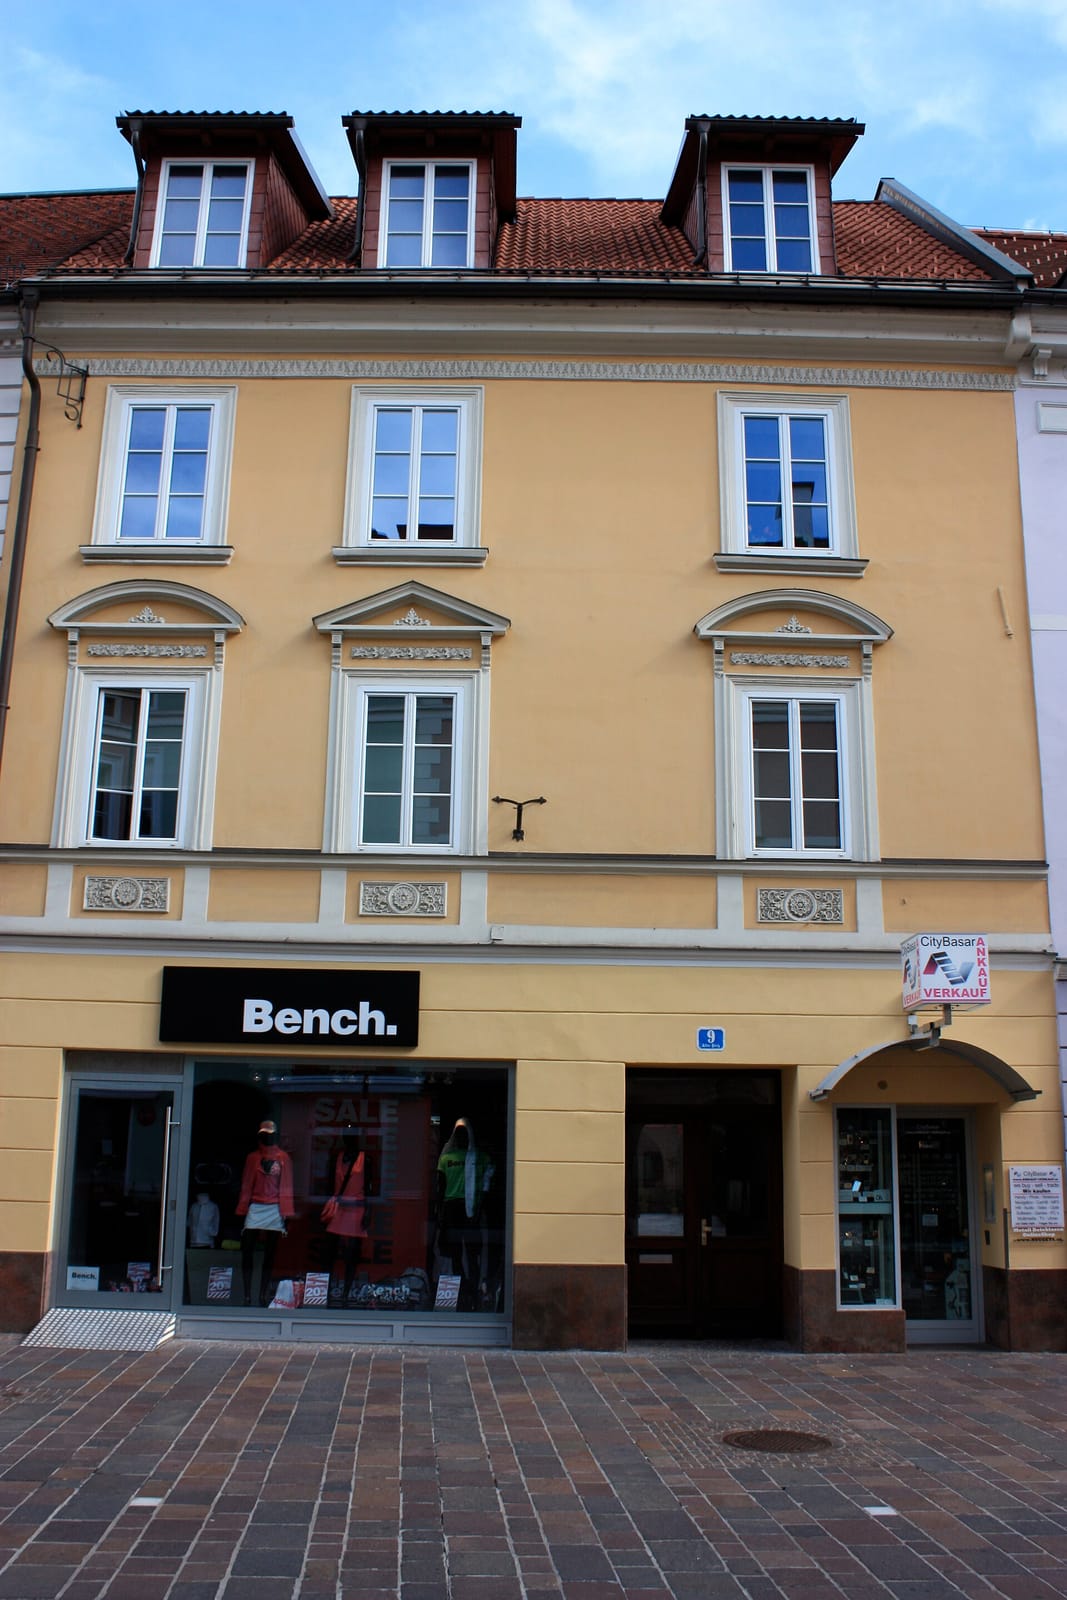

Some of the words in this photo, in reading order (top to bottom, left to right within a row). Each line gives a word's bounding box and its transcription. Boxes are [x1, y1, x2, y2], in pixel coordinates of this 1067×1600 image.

[921, 936, 975, 949] CityBasar
[924, 988, 987, 998] VERKAUF
[243, 999, 397, 1036] Bench.
[707, 1030, 716, 1044] 9
[315, 1098, 400, 1123] SALE
